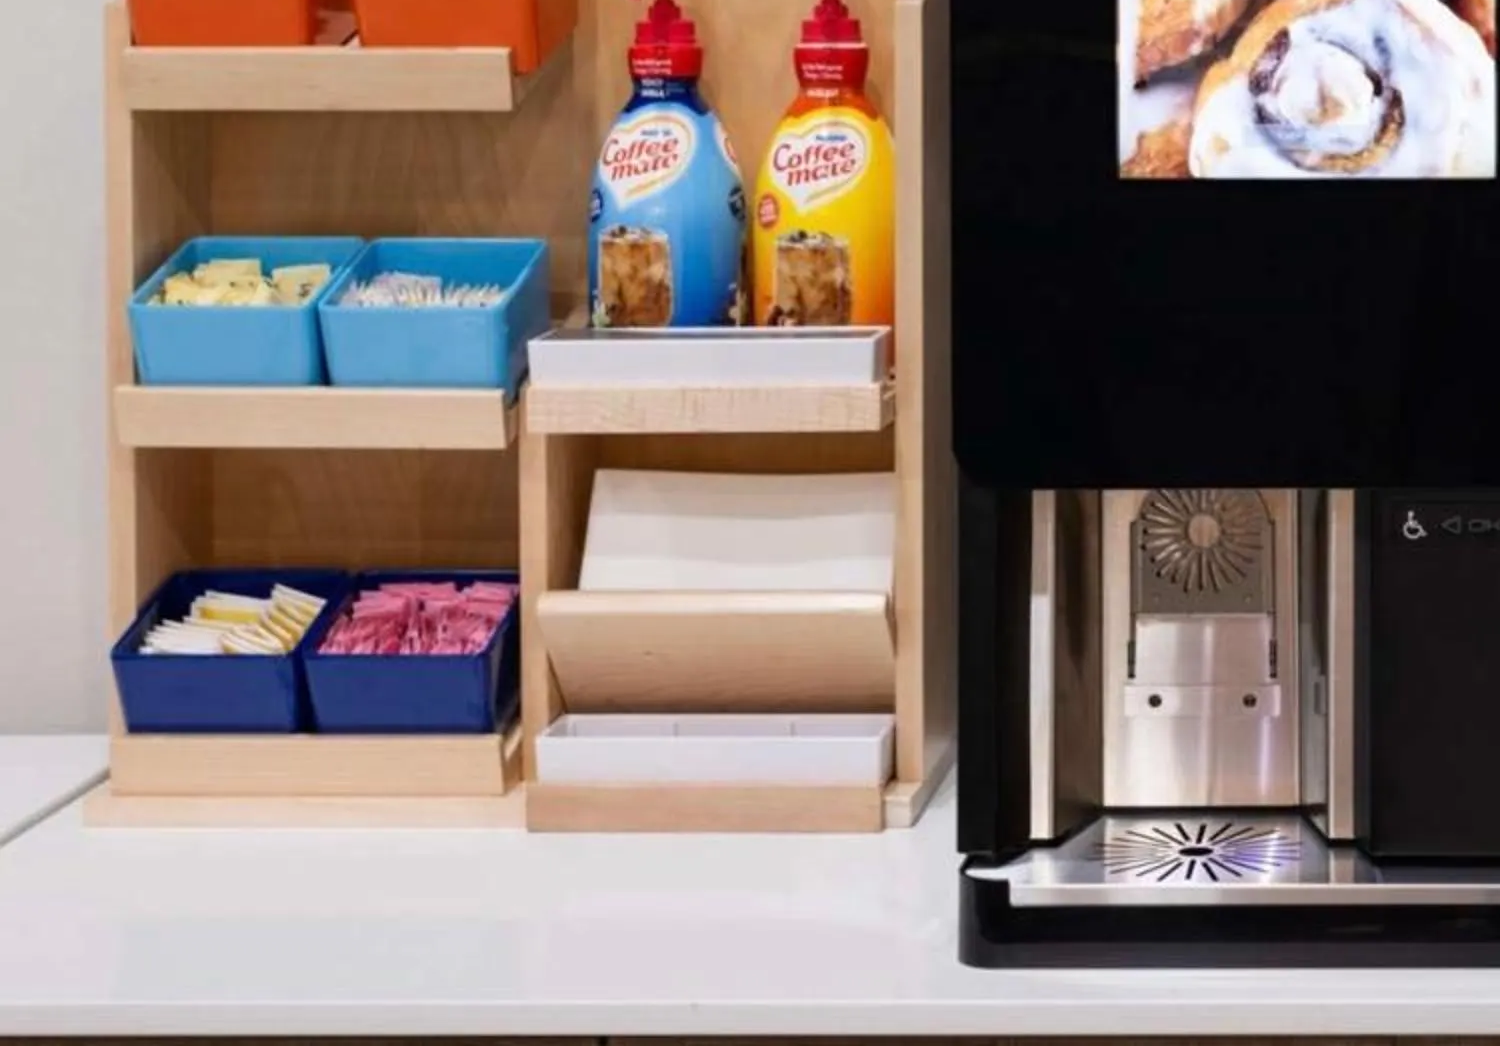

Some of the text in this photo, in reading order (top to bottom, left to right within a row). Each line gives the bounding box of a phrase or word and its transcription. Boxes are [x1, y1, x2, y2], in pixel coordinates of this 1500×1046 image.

[602, 137, 679, 167] Coffee
[773, 141, 856, 172] Coffee
[611, 154, 679, 181] mate
[787, 158, 856, 187] mate
